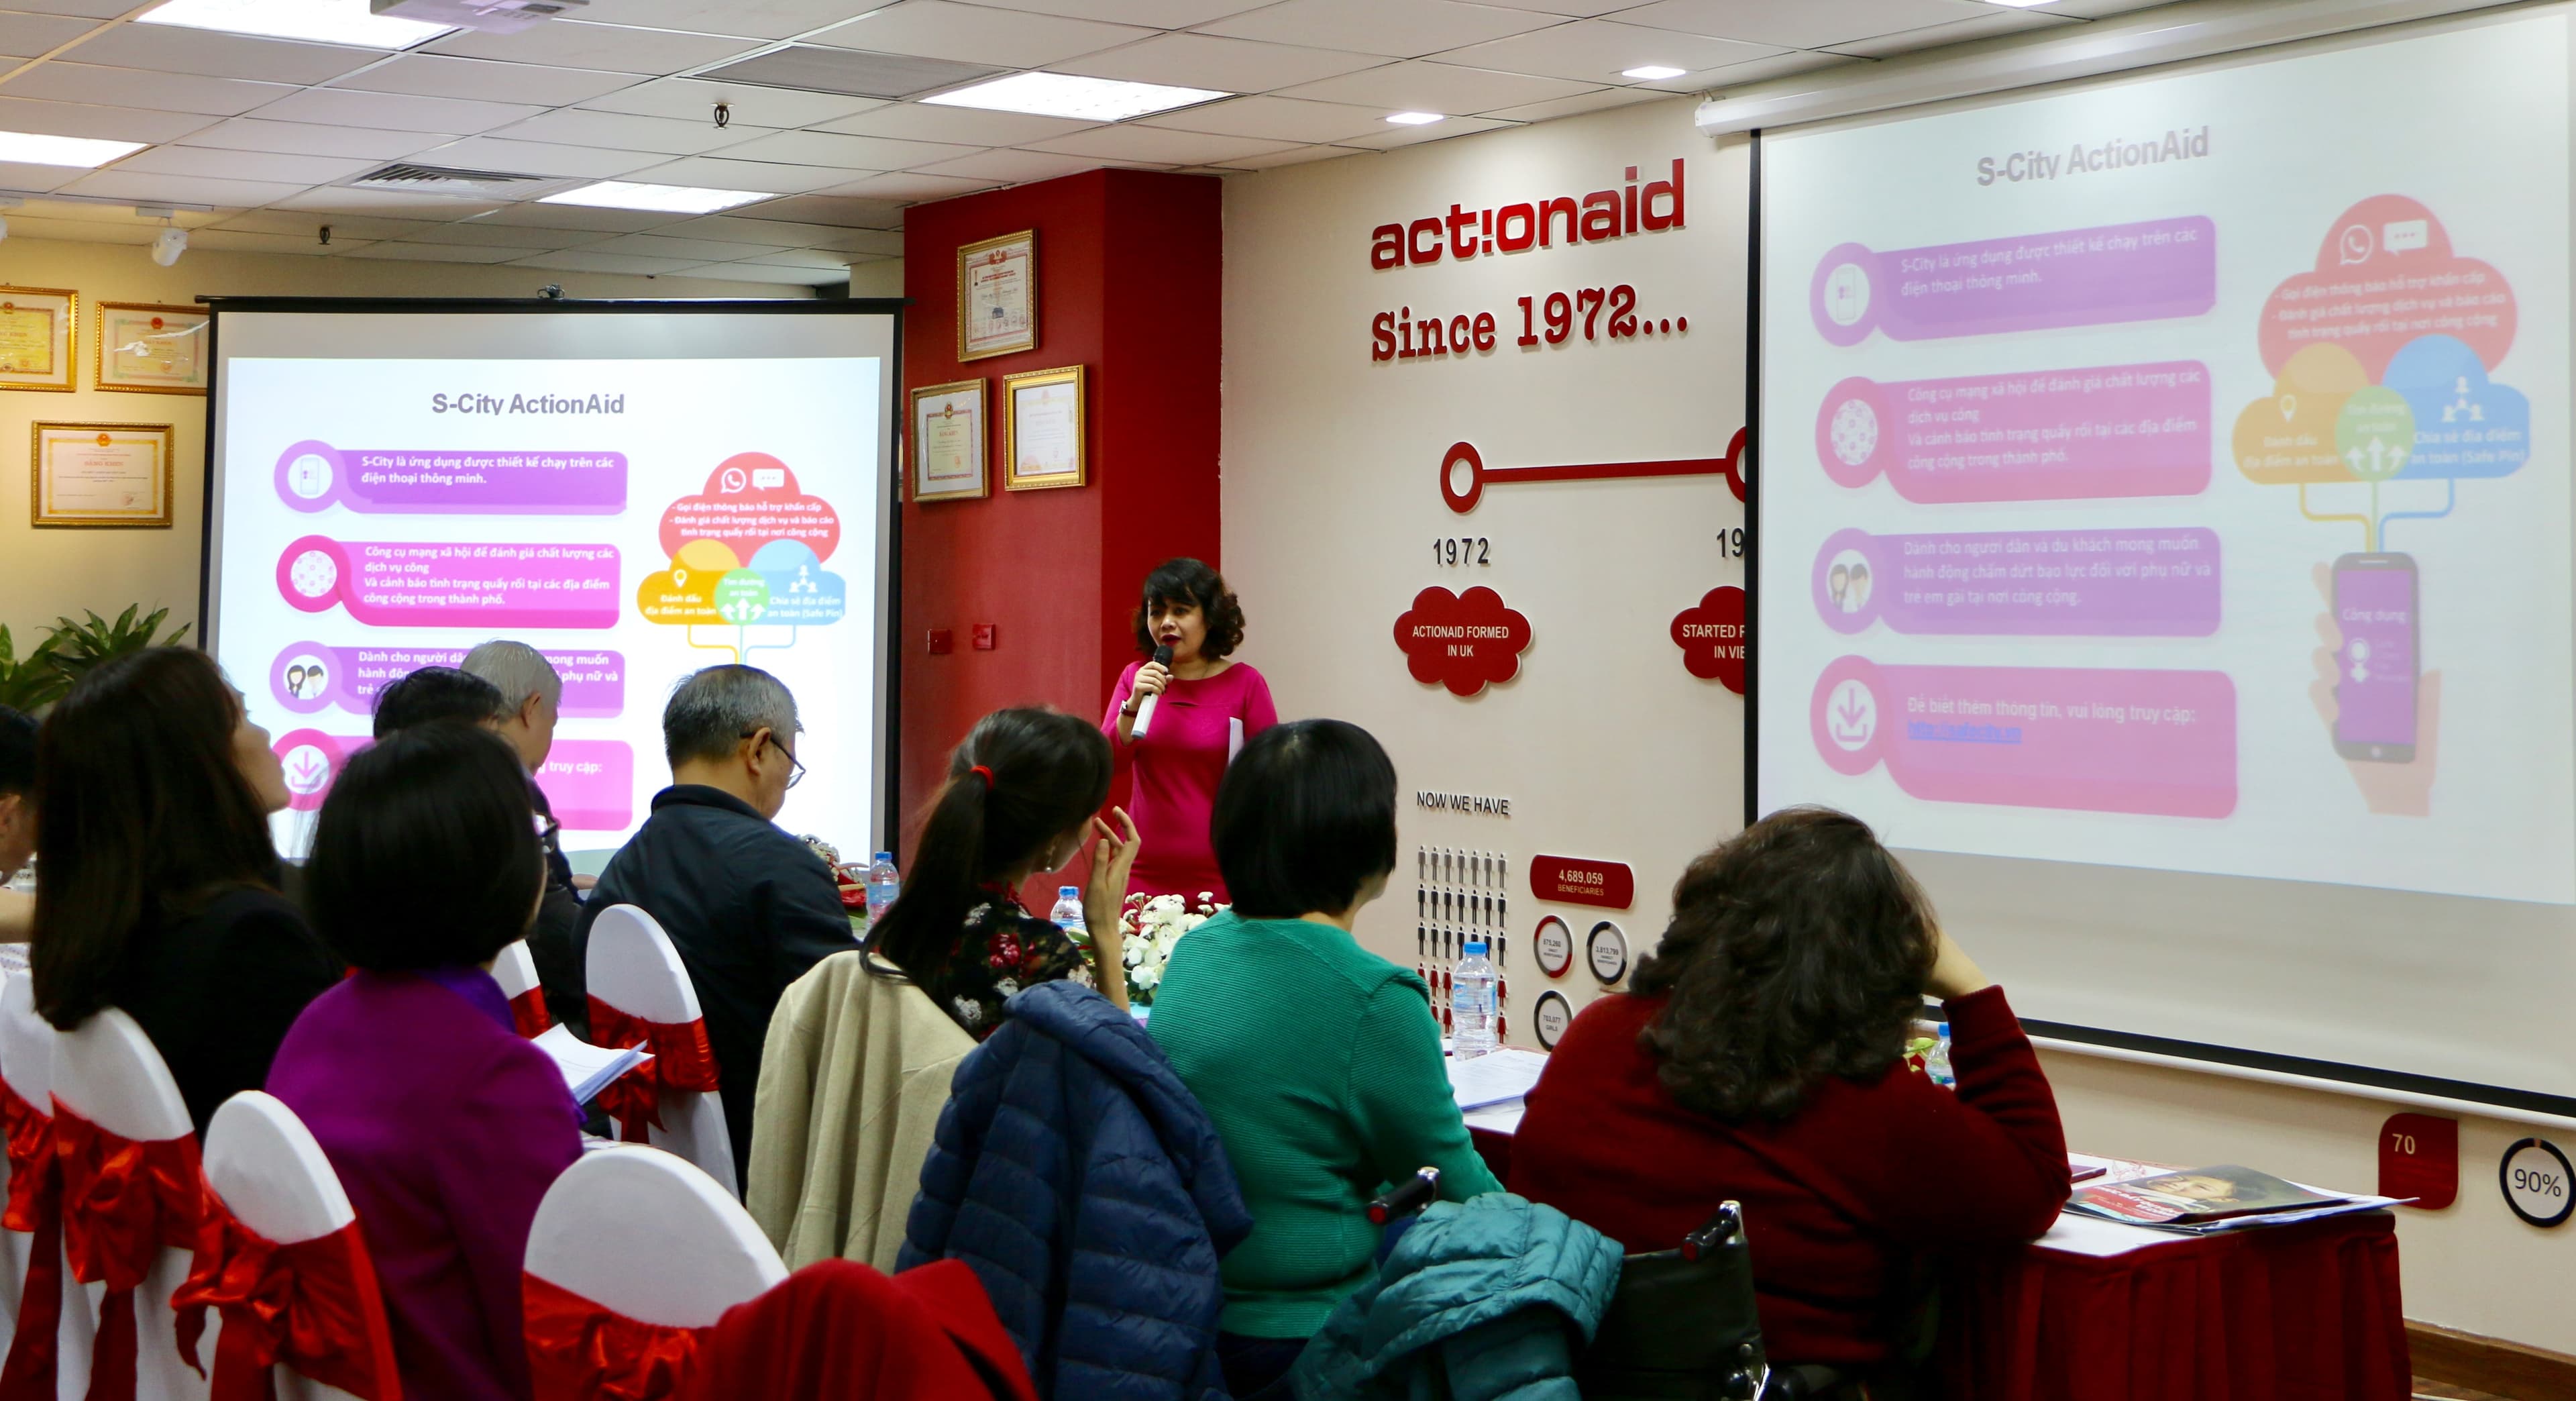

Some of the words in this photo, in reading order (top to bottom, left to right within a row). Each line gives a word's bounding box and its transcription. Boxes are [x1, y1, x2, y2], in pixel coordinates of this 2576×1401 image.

[1976, 150, 2061, 186] S-City
[2065, 125, 2208, 175] ActionAid
[1372, 307, 1496, 361] Since
[1517, 284, 1687, 346] 1972...
[432, 393, 504, 415] S-City
[508, 393, 625, 413] ActionAid
[362, 456, 393, 469] S-City
[396, 456, 406, 467] là
[409, 456, 431, 470] ứng
[434, 456, 461, 470] dụng
[464, 456, 494, 470] được
[497, 456, 523, 468] thiết
[526, 456, 539, 468] kế
[542, 457, 567, 470] chạy
[570, 457, 592, 468] trên
[596, 457, 614, 468] các
[362, 474, 386, 484] điện
[389, 474, 417, 484] thoại
[421, 474, 452, 486] thông
[455, 474, 486, 484] minh.
[1717, 527, 1745, 558] 19
[366, 546, 391, 558] Công
[394, 549, 405, 558] cụ
[409, 549, 438, 559] mạng
[441, 548, 451, 557] xã
[455, 547, 470, 558] hội
[474, 546, 487, 558] để
[490, 547, 516, 558] đánh
[519, 548, 534, 560] giá
[537, 546, 559, 558] chất
[562, 548, 594, 560] lượng
[597, 548, 614, 559] các
[1434, 537, 1489, 564] 1972
[365, 562, 387, 573] dịch
[389, 564, 402, 573] vụ
[405, 562, 429, 574] công
[1412, 625, 1464, 637] ACTIONAID
[1466, 626, 1509, 639] FORMED
[1682, 625, 1735, 638] STARTED
[1448, 644, 1457, 656] IN
[1460, 645, 1473, 657] UK
[1714, 645, 1725, 658] IN
[1728, 645, 1745, 659] VIE
[359, 652, 388, 662] Dành
[390, 652, 410, 662] cho
[413, 652, 447, 664] người
[576, 652, 608, 664] muốn
[358, 668, 386, 678] hành
[561, 671, 583, 683] phụ
[586, 671, 603, 681] nữ
[605, 671, 618, 681] và
[549, 762, 574, 775] truy
[576, 762, 602, 775] cập:
[1417, 791, 1446, 809] NOW
[1450, 794, 1470, 811] WE
[1474, 796, 1509, 815] HAVE
[1558, 869, 1603, 885] 4,689,059
[1558, 884, 1604, 896] BENEFICIARIES
[2392, 1133, 2415, 1155] 70
[2514, 1169, 2561, 1197] 90%
